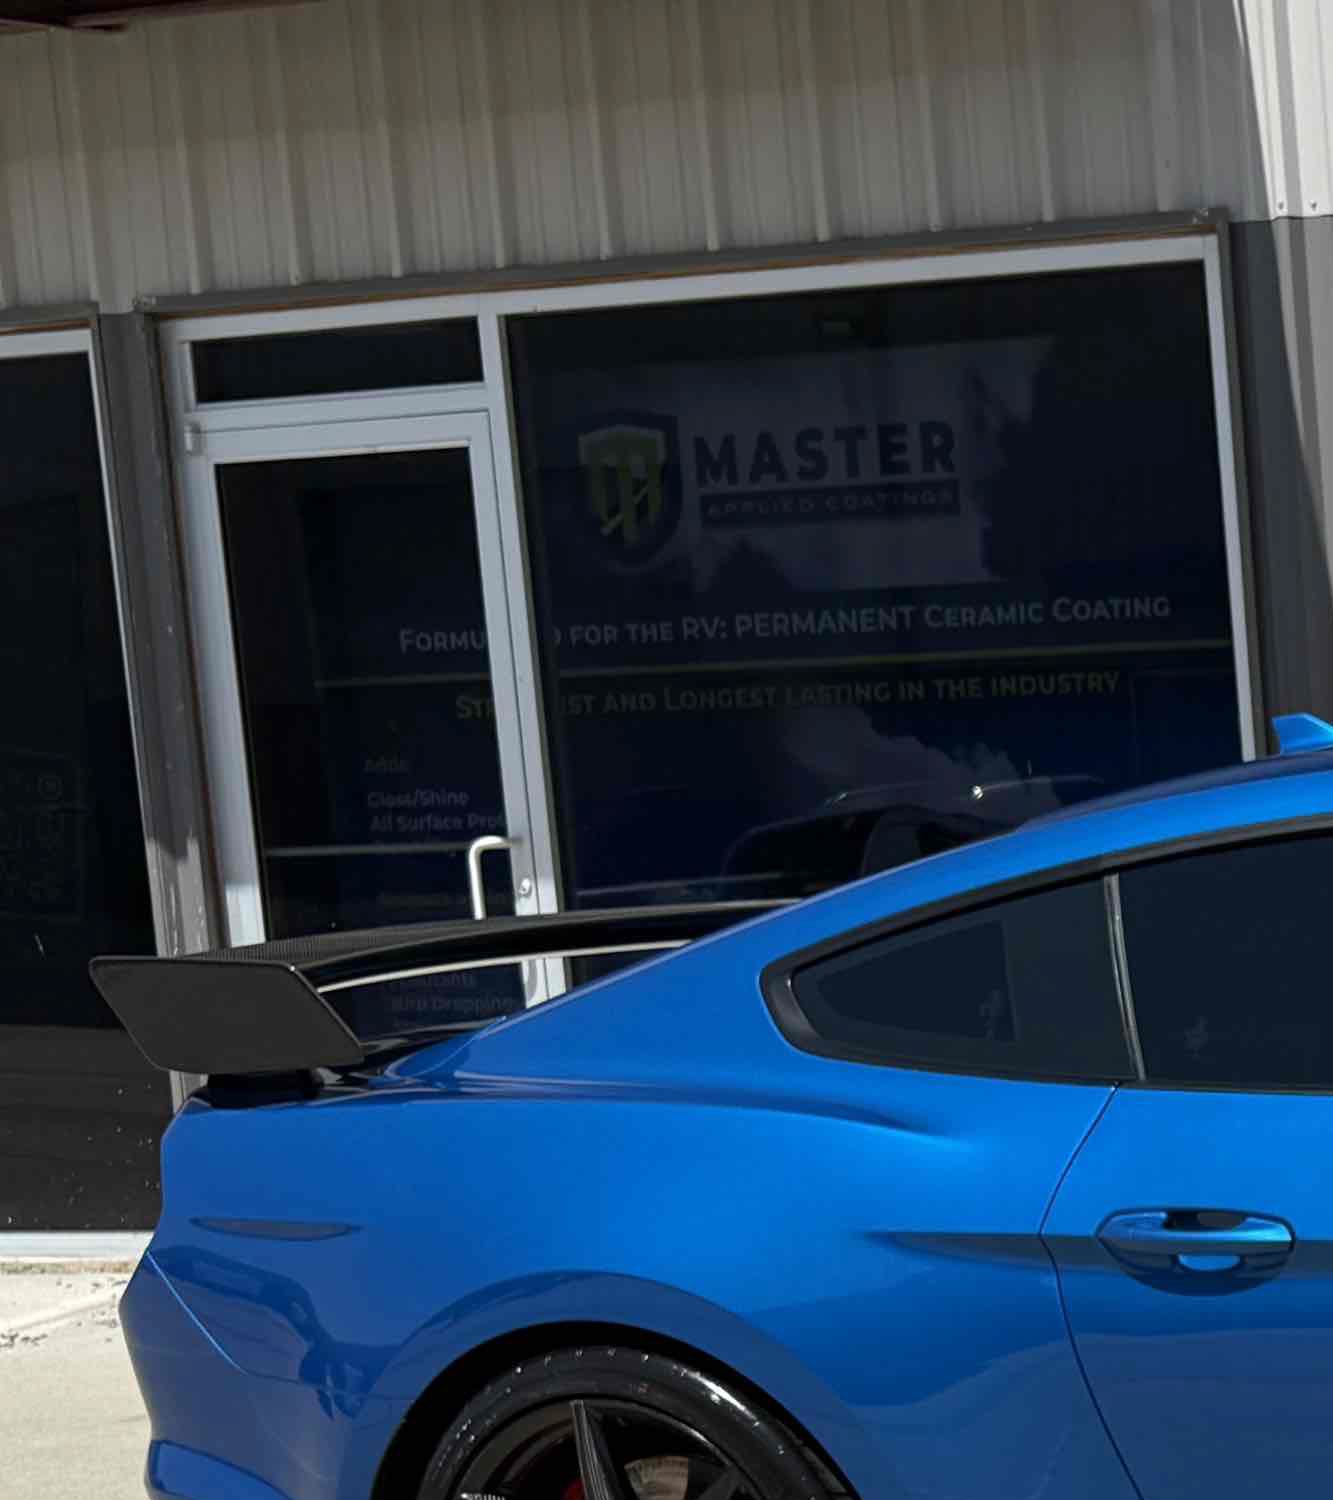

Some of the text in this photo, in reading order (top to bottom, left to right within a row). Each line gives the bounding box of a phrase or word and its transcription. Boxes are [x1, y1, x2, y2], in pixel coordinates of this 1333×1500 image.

[693, 421, 957, 486] MASTER
[569, 622, 619, 648] FOR
[624, 619, 674, 644] THE
[682, 614, 728, 641] RV:
[735, 604, 915, 638] PERMANENT
[923, 600, 1043, 629] CERAMIC
[1051, 595, 1171, 623] COATING
[601, 691, 656, 713] AND
[664, 685, 778, 712] LONGEST
[783, 680, 892, 704] LASTING
[899, 679, 926, 703] IN
[935, 675, 985, 701] THE
[991, 670, 1120, 697] INDUSTRY
[369, 812, 393, 832] All
[396, 811, 464, 833] Surface
